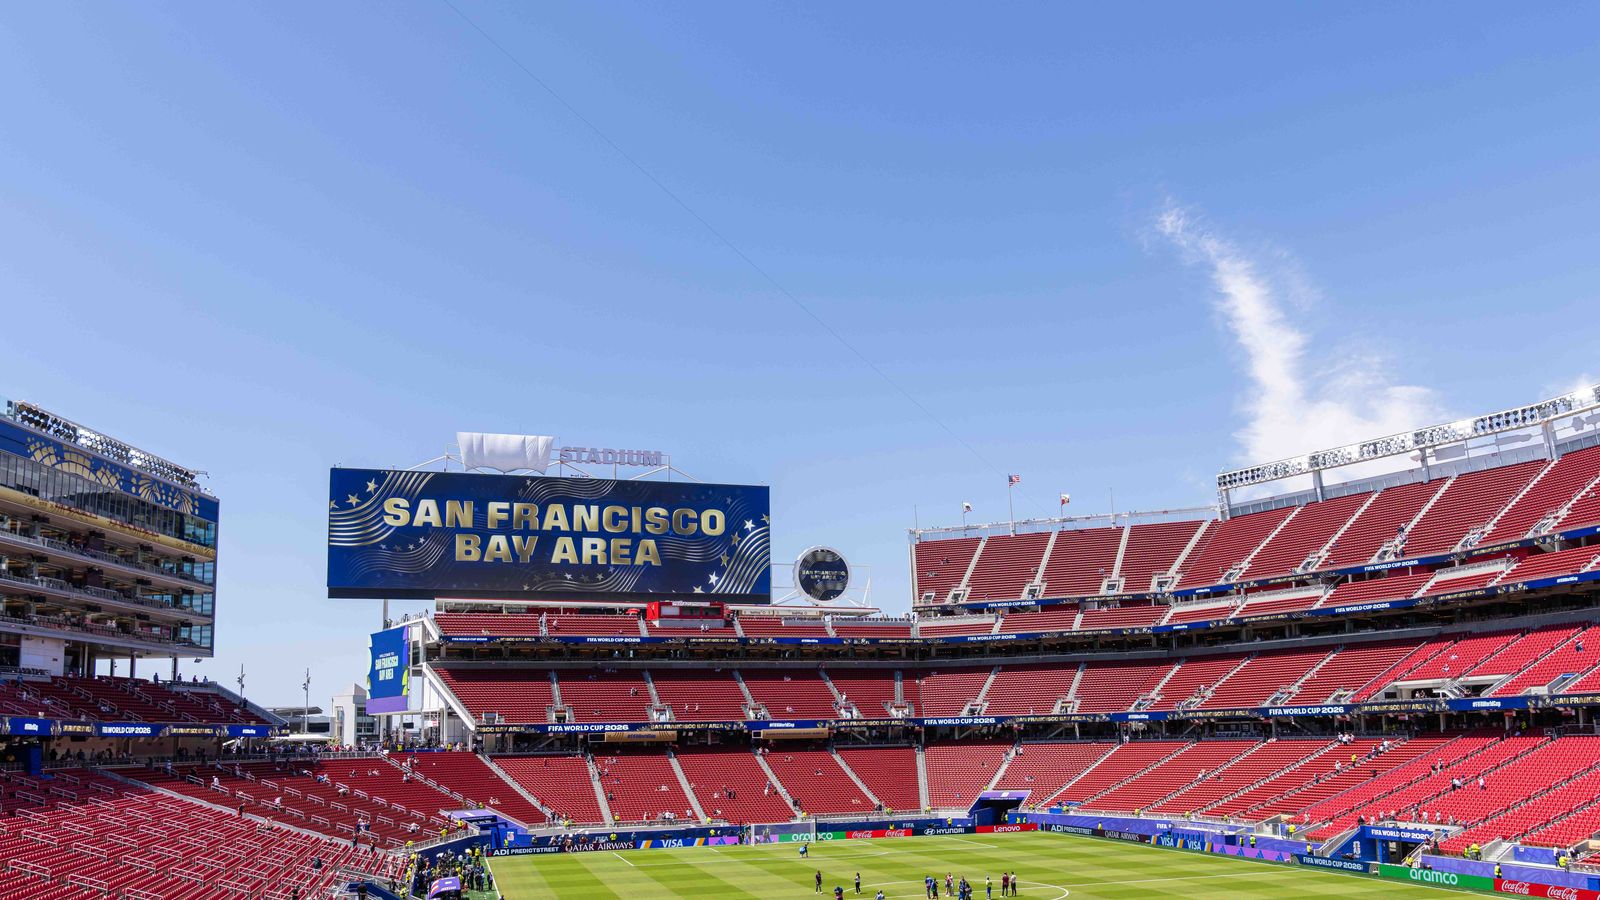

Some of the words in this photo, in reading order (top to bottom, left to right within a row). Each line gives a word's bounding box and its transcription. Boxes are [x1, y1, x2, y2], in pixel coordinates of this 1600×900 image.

[559, 446, 662, 467] STADIUM
[382, 497, 474, 528] SAN
[487, 501, 726, 537] FRANCISCO
[455, 533, 539, 563] BAY
[550, 536, 662, 567] AREA
[994, 825, 1020, 833] Lenovo
[1063, 826, 1092, 835] PREDICTSTREET
[1104, 831, 1119, 839] QATAR
[1120, 833, 1140, 841] AIRWAYS
[565, 843, 595, 852] QATAR
[598, 841, 634, 850] AIRWAYS
[661, 839, 683, 848] VISA
[1161, 837, 1174, 847] VISA
[1187, 840, 1201, 851] VISA
[511, 846, 559, 855] PREDICTSTREET
[1343, 863, 1362, 871] 2026
[1409, 868, 1458, 885] aramco
